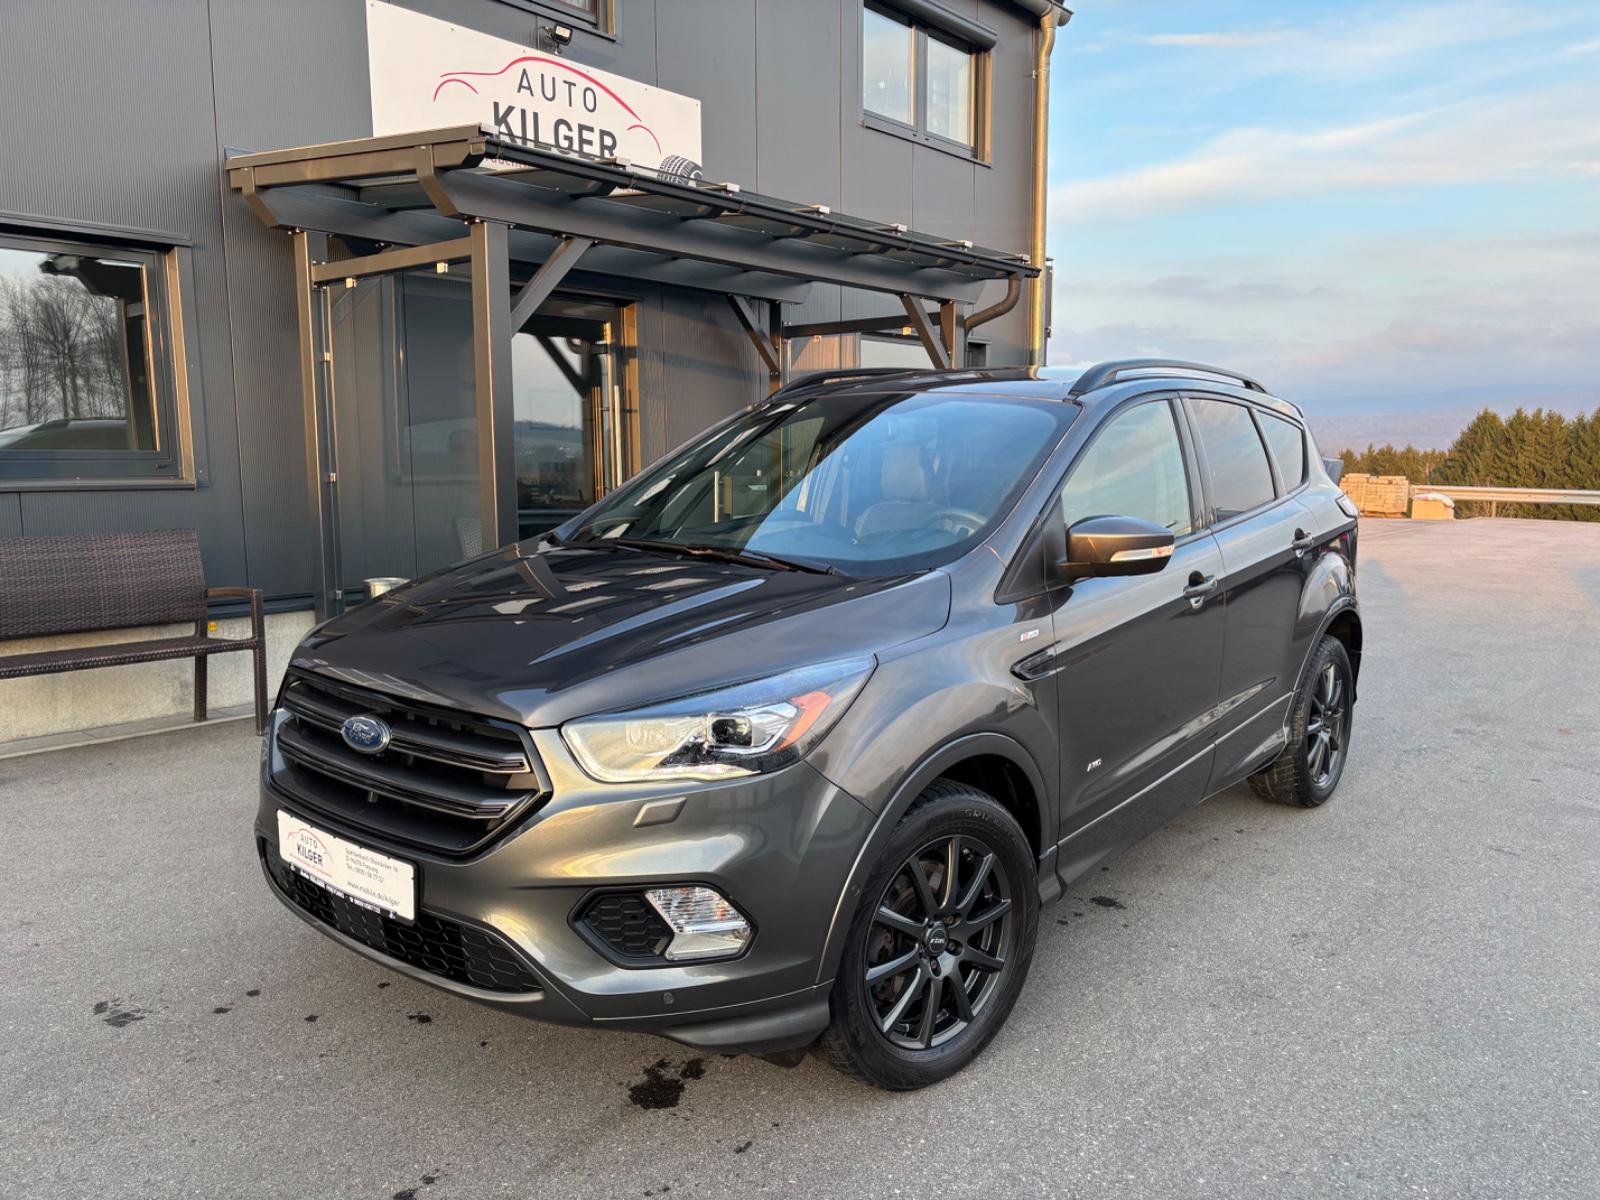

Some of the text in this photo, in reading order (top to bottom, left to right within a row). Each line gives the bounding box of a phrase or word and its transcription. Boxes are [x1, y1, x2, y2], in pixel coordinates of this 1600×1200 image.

[516, 67, 597, 113] AUTO
[493, 101, 618, 160] KILGER
[296, 842, 323, 867] KILGER
[300, 832, 318, 850] AUTO
